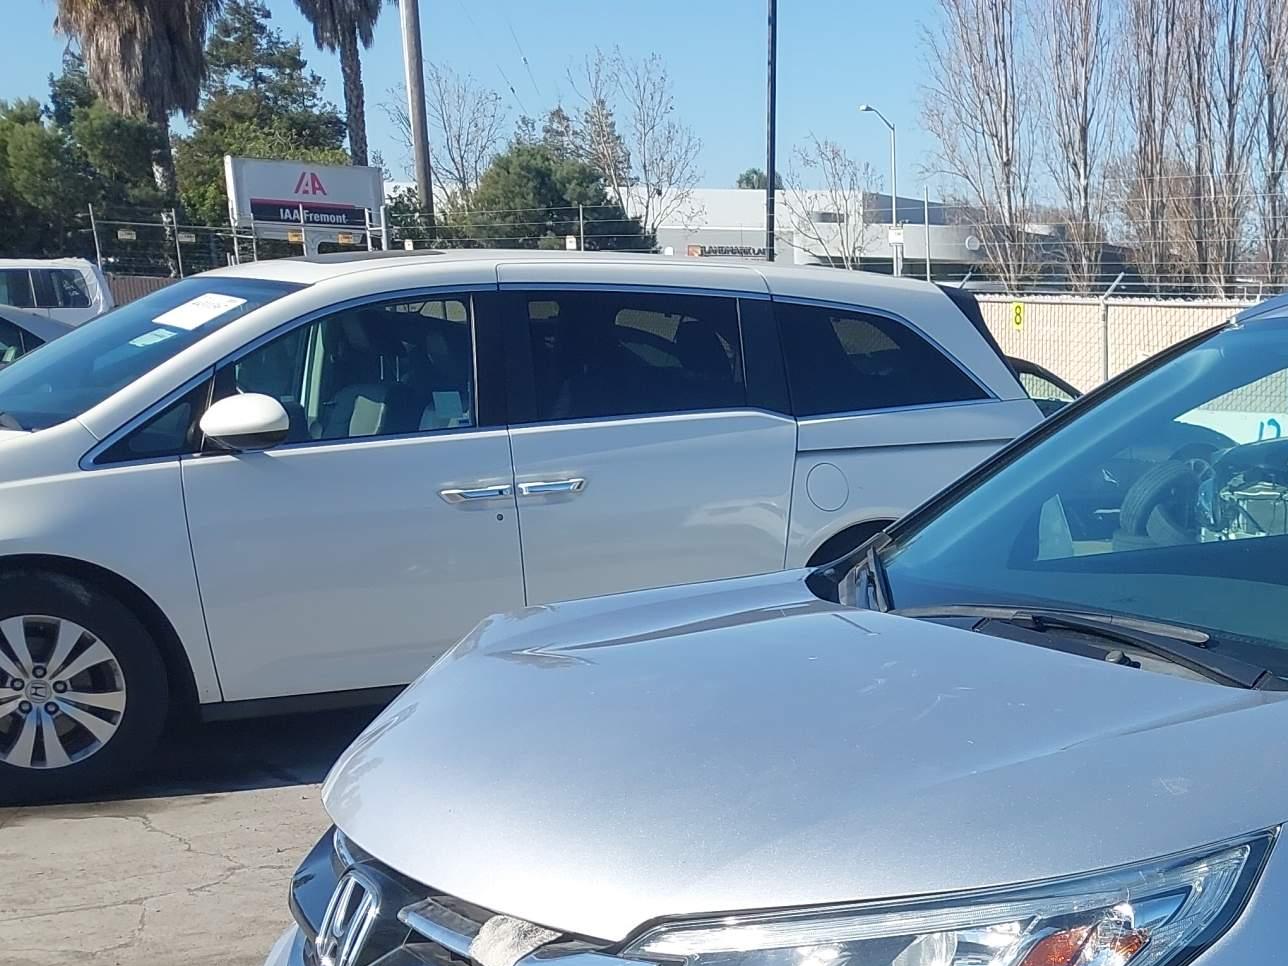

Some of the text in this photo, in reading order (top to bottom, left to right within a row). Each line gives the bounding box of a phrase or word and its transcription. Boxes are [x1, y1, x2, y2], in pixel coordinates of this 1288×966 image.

[279, 208, 347, 224] IAA Fremont
[1014, 305, 1022, 326] 8
